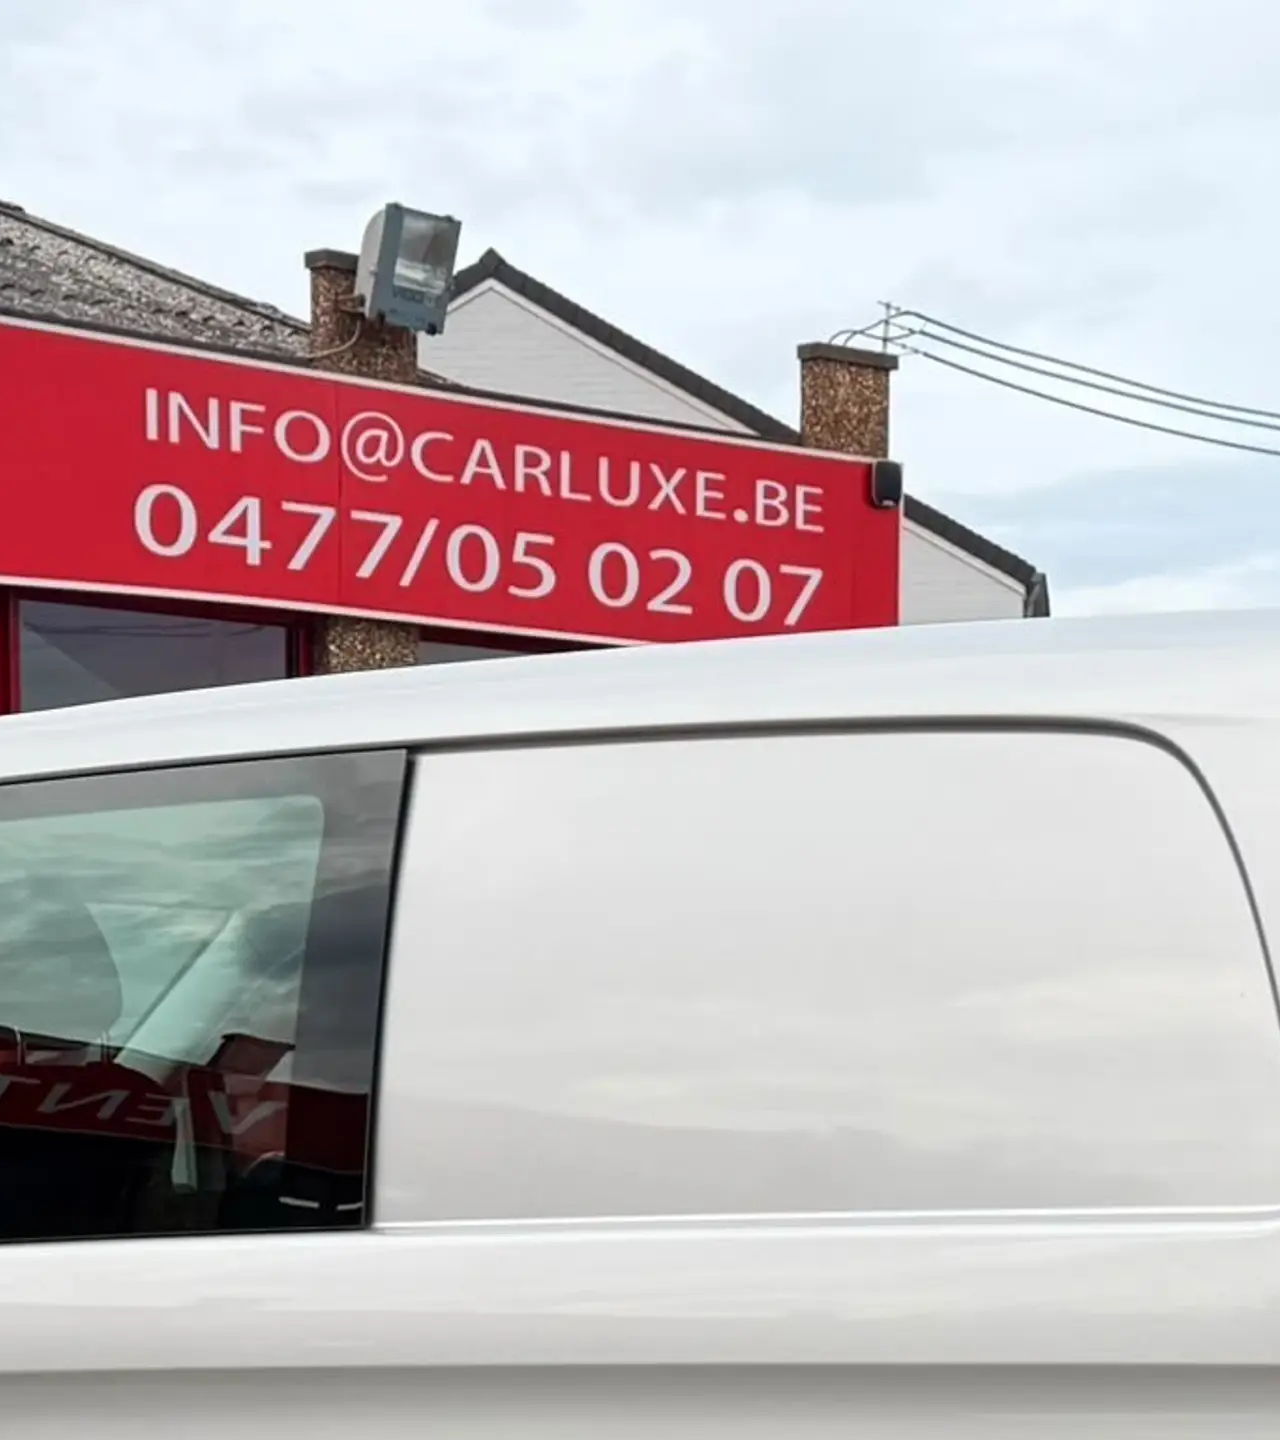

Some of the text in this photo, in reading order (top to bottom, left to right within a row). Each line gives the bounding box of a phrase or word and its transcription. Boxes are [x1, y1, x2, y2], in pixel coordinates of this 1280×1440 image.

[145, 388, 824, 533] INFO@CARLUXE.BE
[134, 484, 823, 627] 0477/05 02 07
